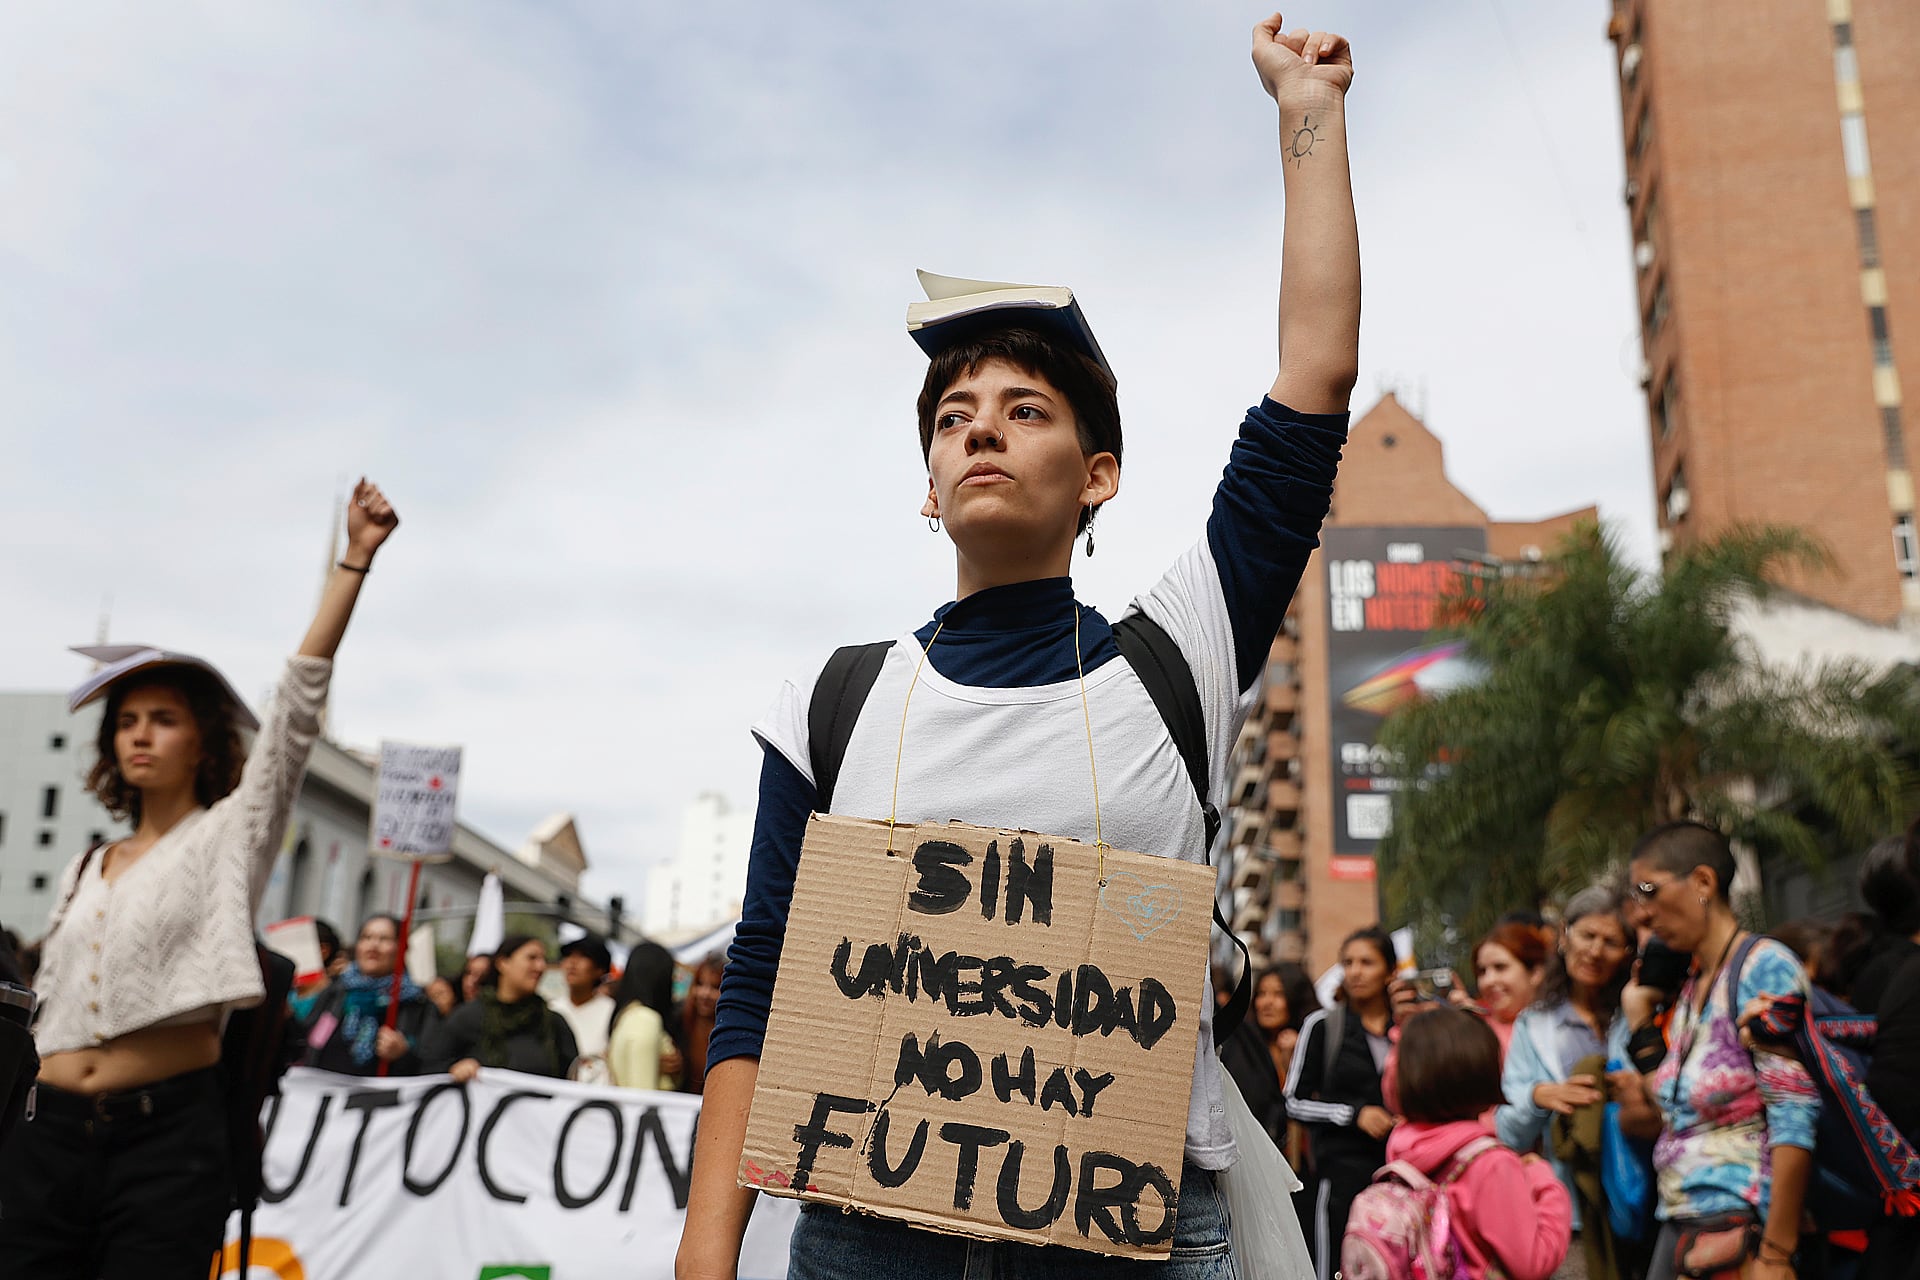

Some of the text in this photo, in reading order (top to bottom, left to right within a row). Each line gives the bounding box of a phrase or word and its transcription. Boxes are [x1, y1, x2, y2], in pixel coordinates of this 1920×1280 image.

[1329, 560, 1375, 598] LOS
[1331, 597, 1364, 632] EN
[907, 837, 1054, 927] SIN
[894, 1029, 1115, 1118] NO HAY
[793, 1092, 1179, 1247] FUTURO
